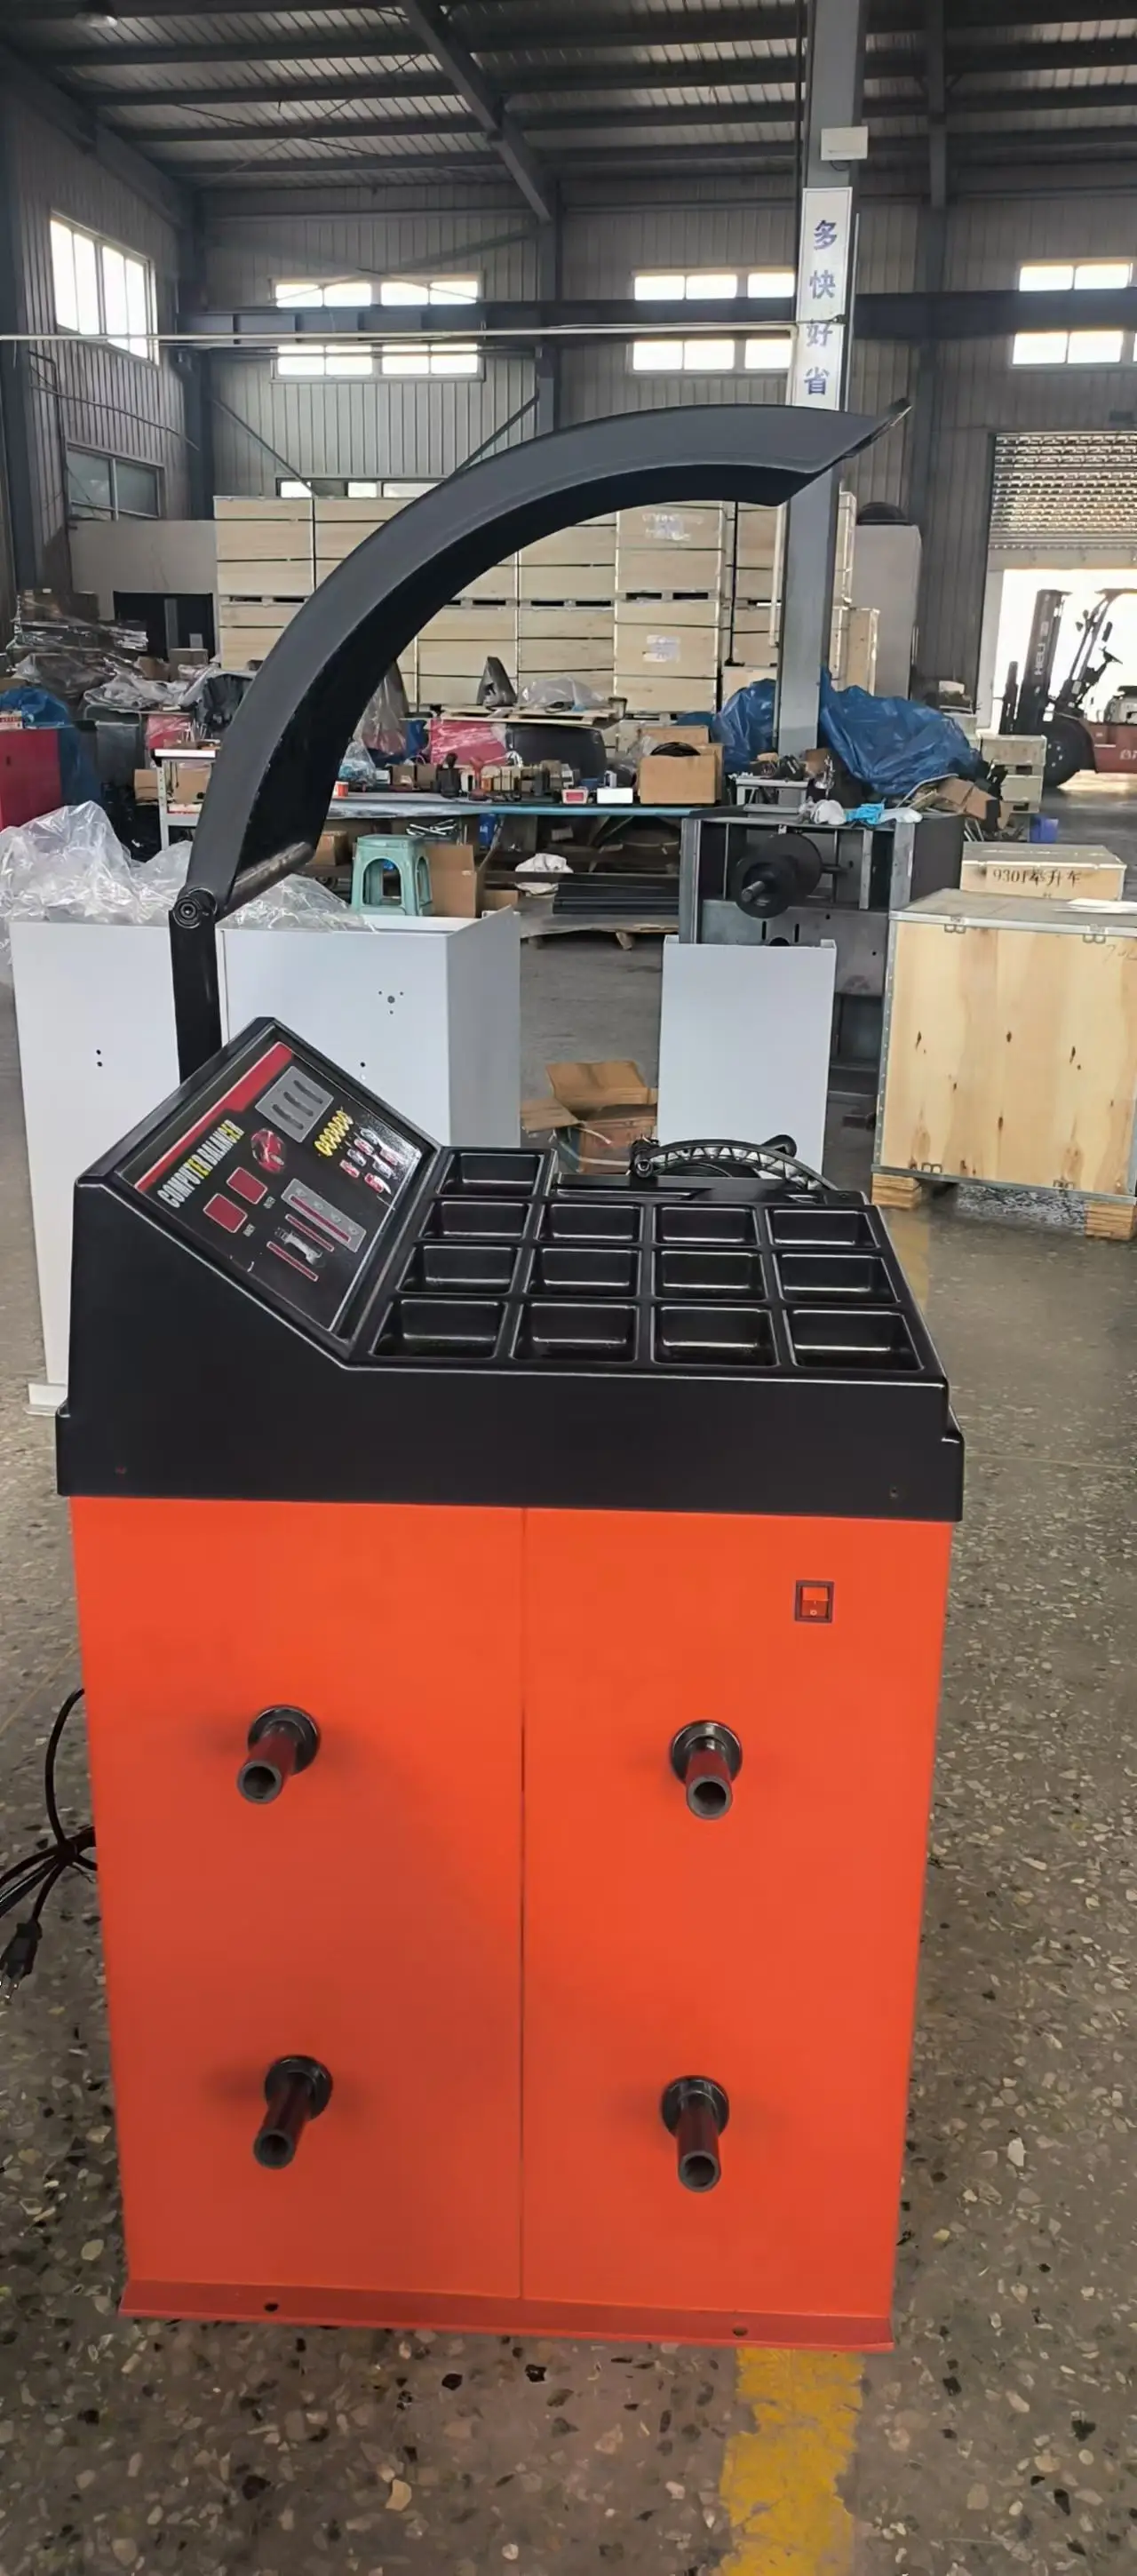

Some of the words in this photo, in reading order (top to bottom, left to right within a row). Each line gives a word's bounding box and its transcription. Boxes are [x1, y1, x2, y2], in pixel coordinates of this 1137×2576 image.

[804, 219, 838, 396] 多快好省
[156, 1154, 214, 1208] COMPUTER
[196, 1119, 245, 1166] BALANCER
